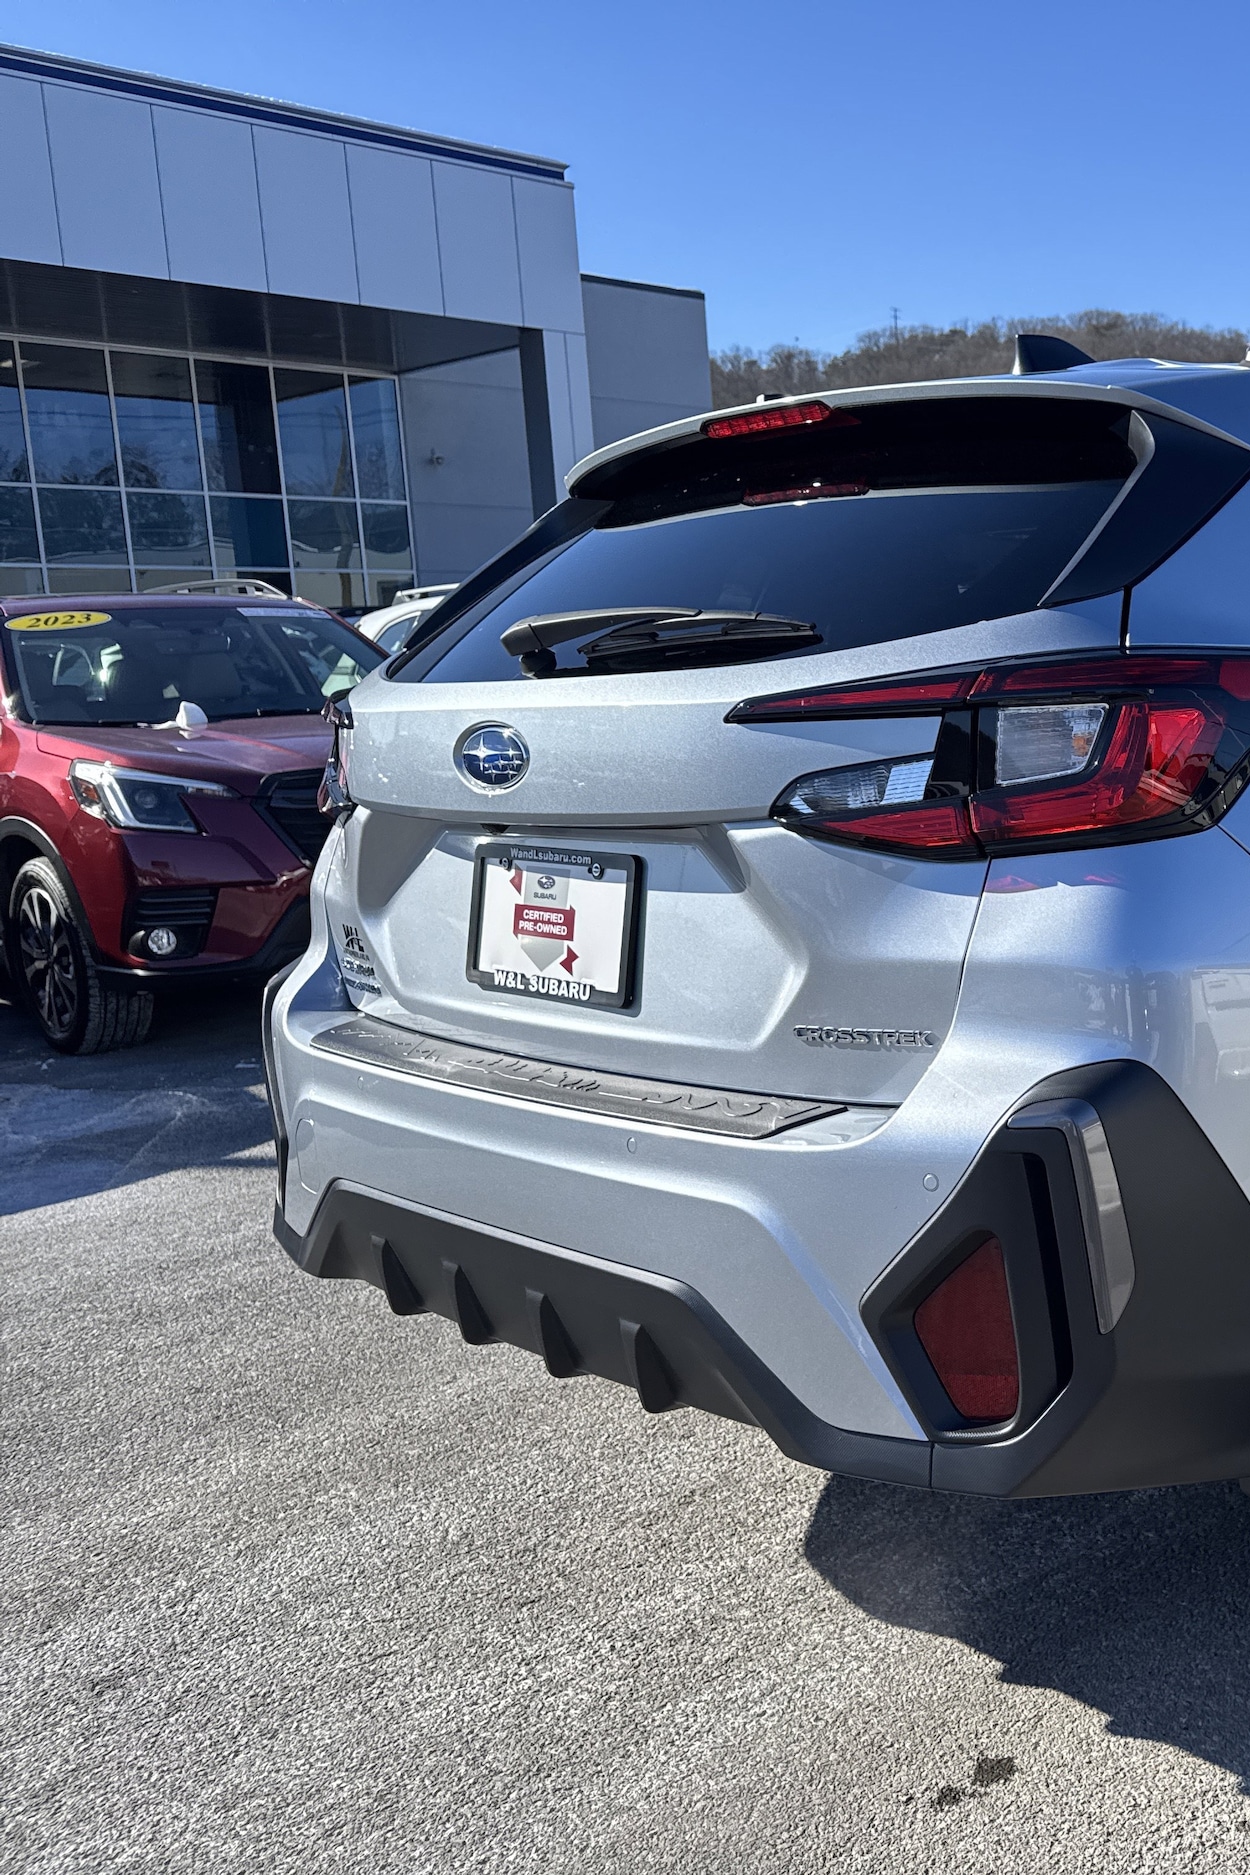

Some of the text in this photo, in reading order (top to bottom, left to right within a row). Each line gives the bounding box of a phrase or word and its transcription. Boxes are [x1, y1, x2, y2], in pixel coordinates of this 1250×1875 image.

[26, 613, 92, 629] 2023
[510, 847, 592, 865] WandLsubaru.com
[533, 891, 557, 901] SUBARU
[522, 909, 565, 924] CERTIFIED
[518, 920, 568, 936] PRE-OWNED
[493, 969, 591, 1001] W&L SUBARU
[793, 1025, 934, 1048] CROSSTREK
